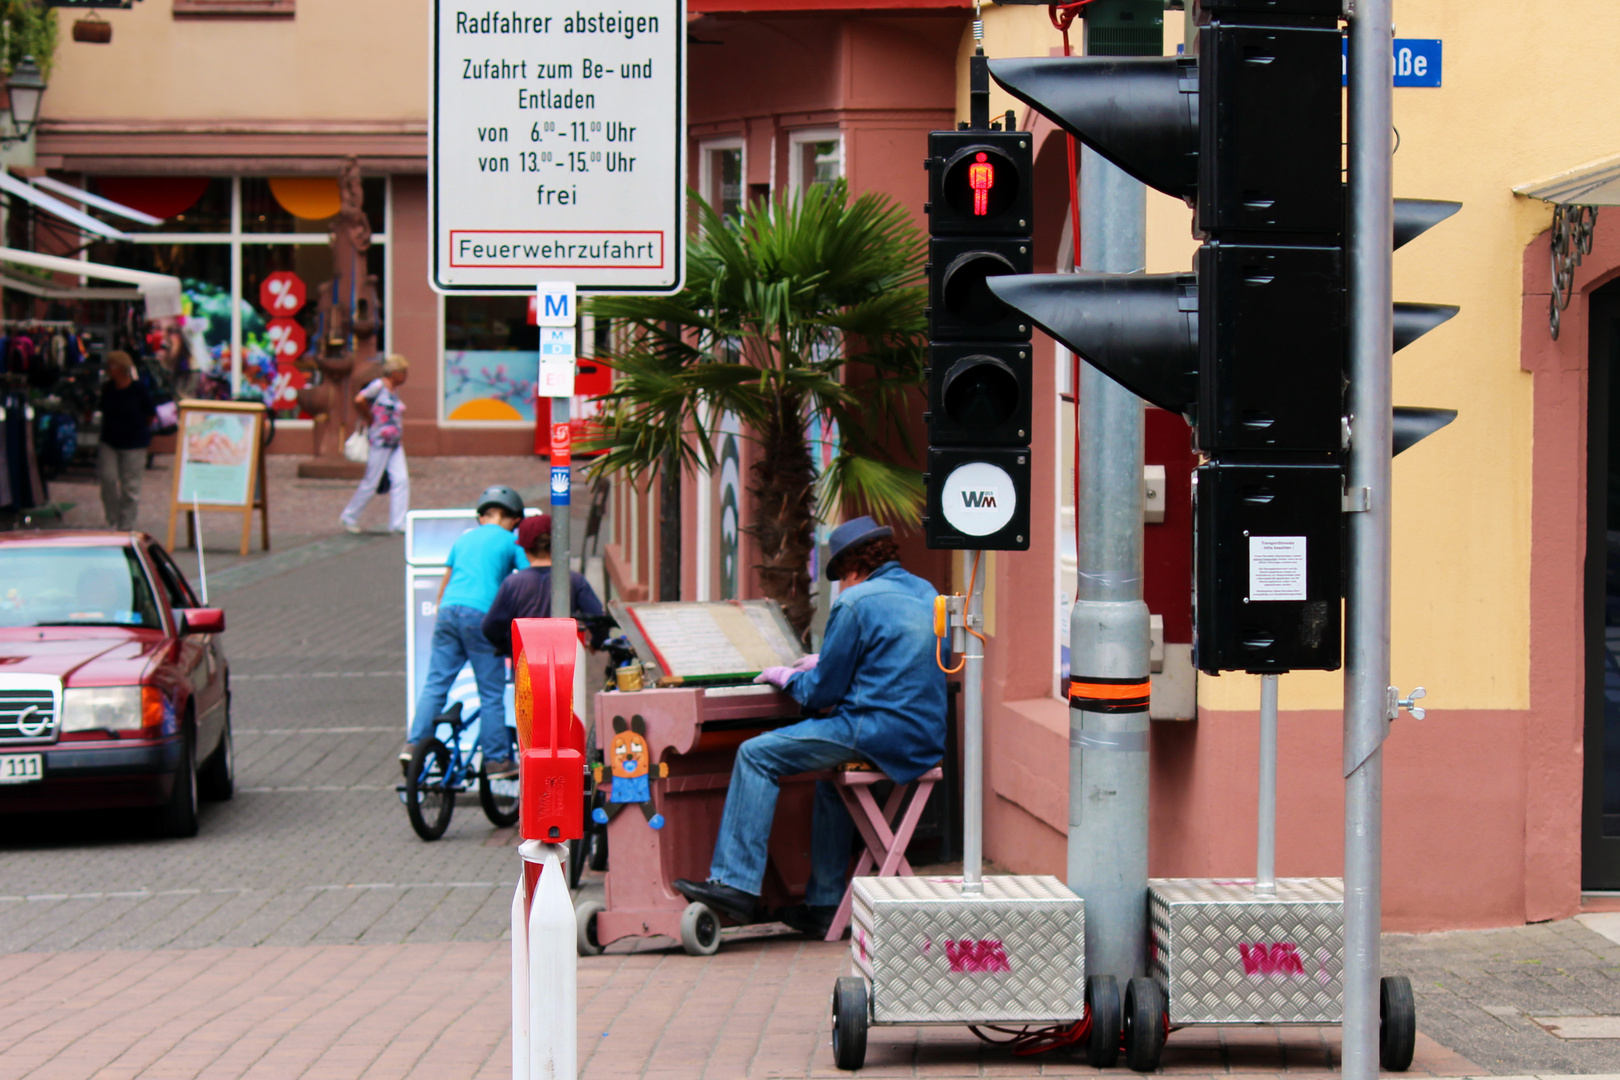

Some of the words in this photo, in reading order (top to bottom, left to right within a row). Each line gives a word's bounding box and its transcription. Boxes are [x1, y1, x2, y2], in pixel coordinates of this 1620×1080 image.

[456, 11, 553, 34] Radfahrer
[563, 11, 660, 40] absteigen
[462, 58, 527, 79] Zufahrt
[537, 64, 573, 79] zum
[582, 58, 614, 79] Be-
[620, 58, 652, 79] und
[518, 88, 596, 110] Entladen
[477, 126, 509, 142] von
[606, 121, 637, 142] Uhr
[478, 156, 509, 172] von
[606, 151, 637, 172] Uhr
[537, 184, 577, 205] frei
[459, 239, 655, 260] Feuerwehrzufahrt
[545, 294, 568, 317] M
[6, 757, 39, 777] 111
